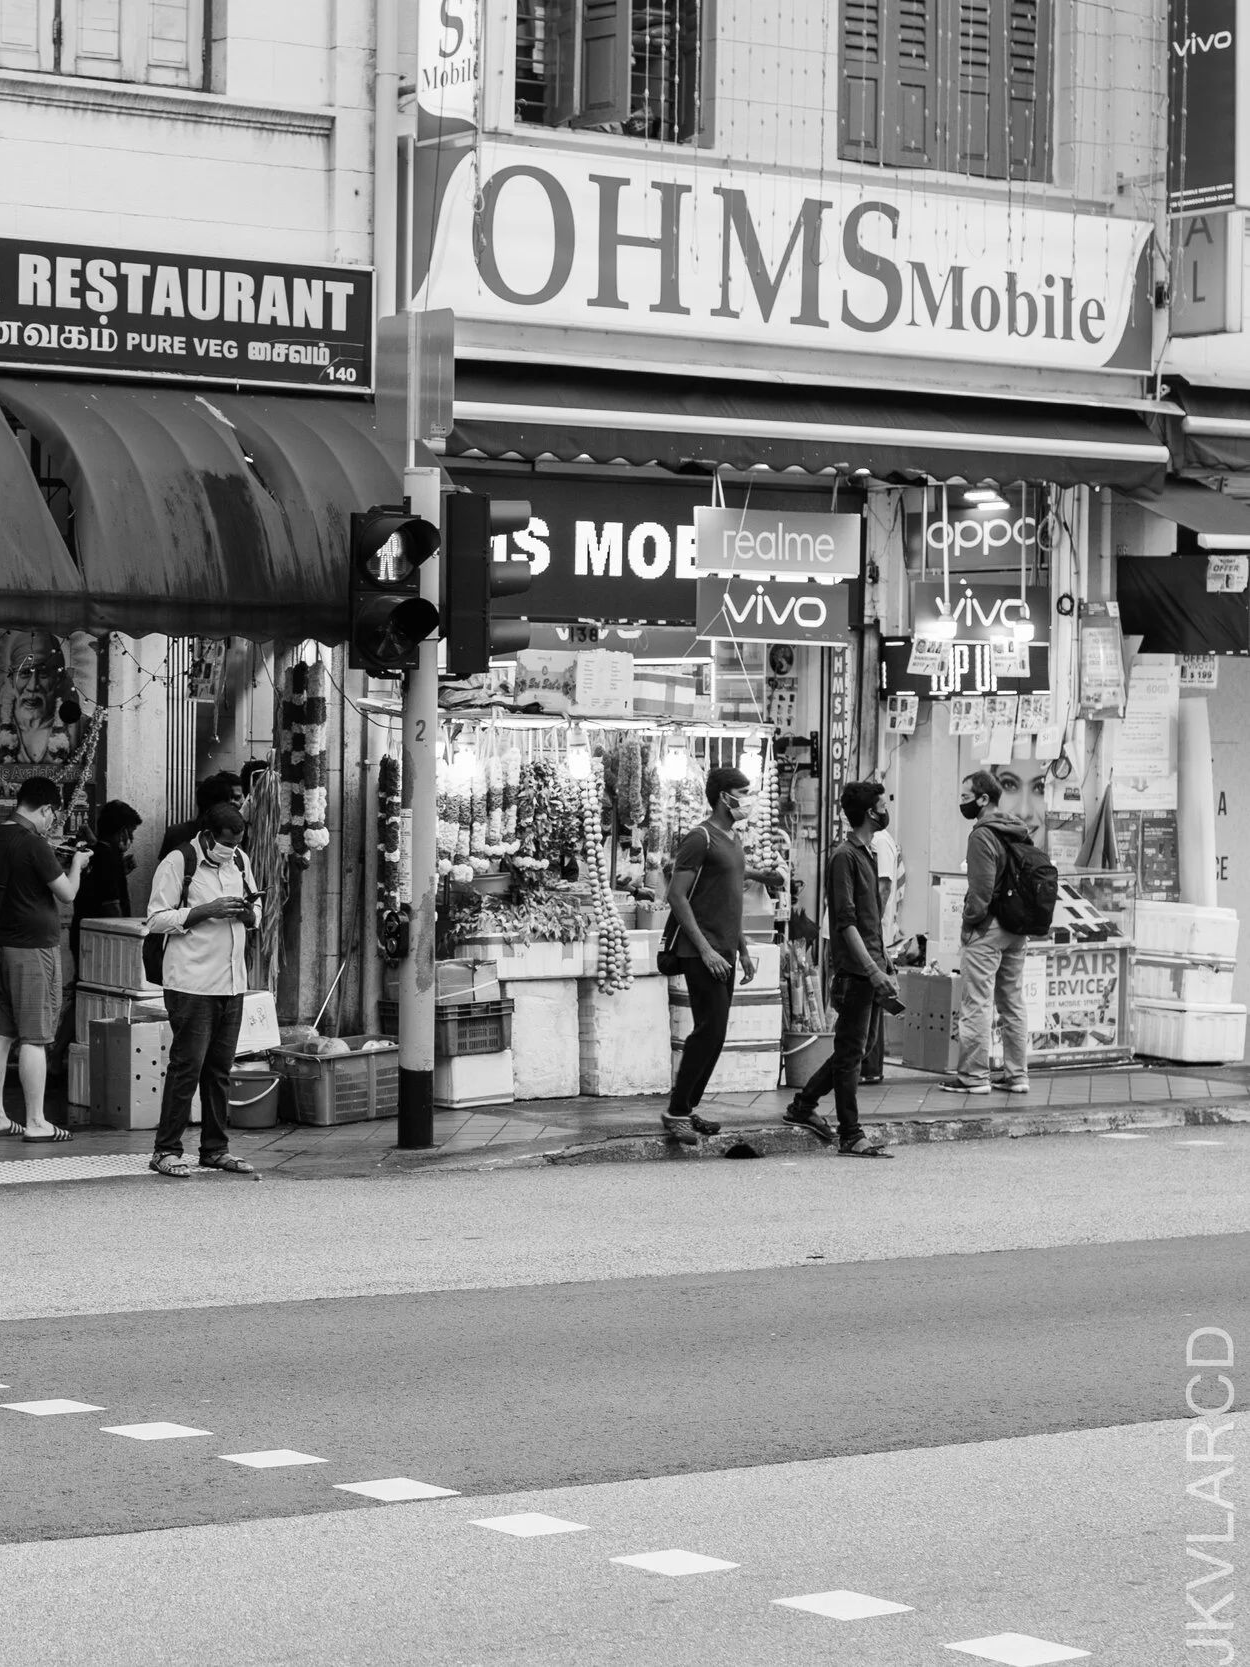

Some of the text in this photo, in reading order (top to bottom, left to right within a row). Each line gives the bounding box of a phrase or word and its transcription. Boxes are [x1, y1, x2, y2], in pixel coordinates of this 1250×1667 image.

[1172, 30, 1232, 57] vivo
[423, 58, 478, 92] Mobile
[472, 165, 1107, 345] OHMS Mobile
[19, 253, 354, 331] RESTAURANT
[126, 333, 238, 359] PURE VEG
[248, 338, 329, 366] சைவம்
[327, 366, 357, 383] 140
[722, 522, 835, 562] realme
[927, 516, 1036, 557] oppo
[723, 585, 827, 628] vivo
[935, 588, 1031, 628] vivo
[570, 626, 598, 643] 138
[1183, 654, 1216, 663] OFFER
[1198, 671, 1212, 679] 199
[415, 719, 426, 742] 2
[12, 765, 59, 780] Availabl
[1046, 952, 1116, 977] EPAIR
[1047, 978, 1105, 996] ERVICE
